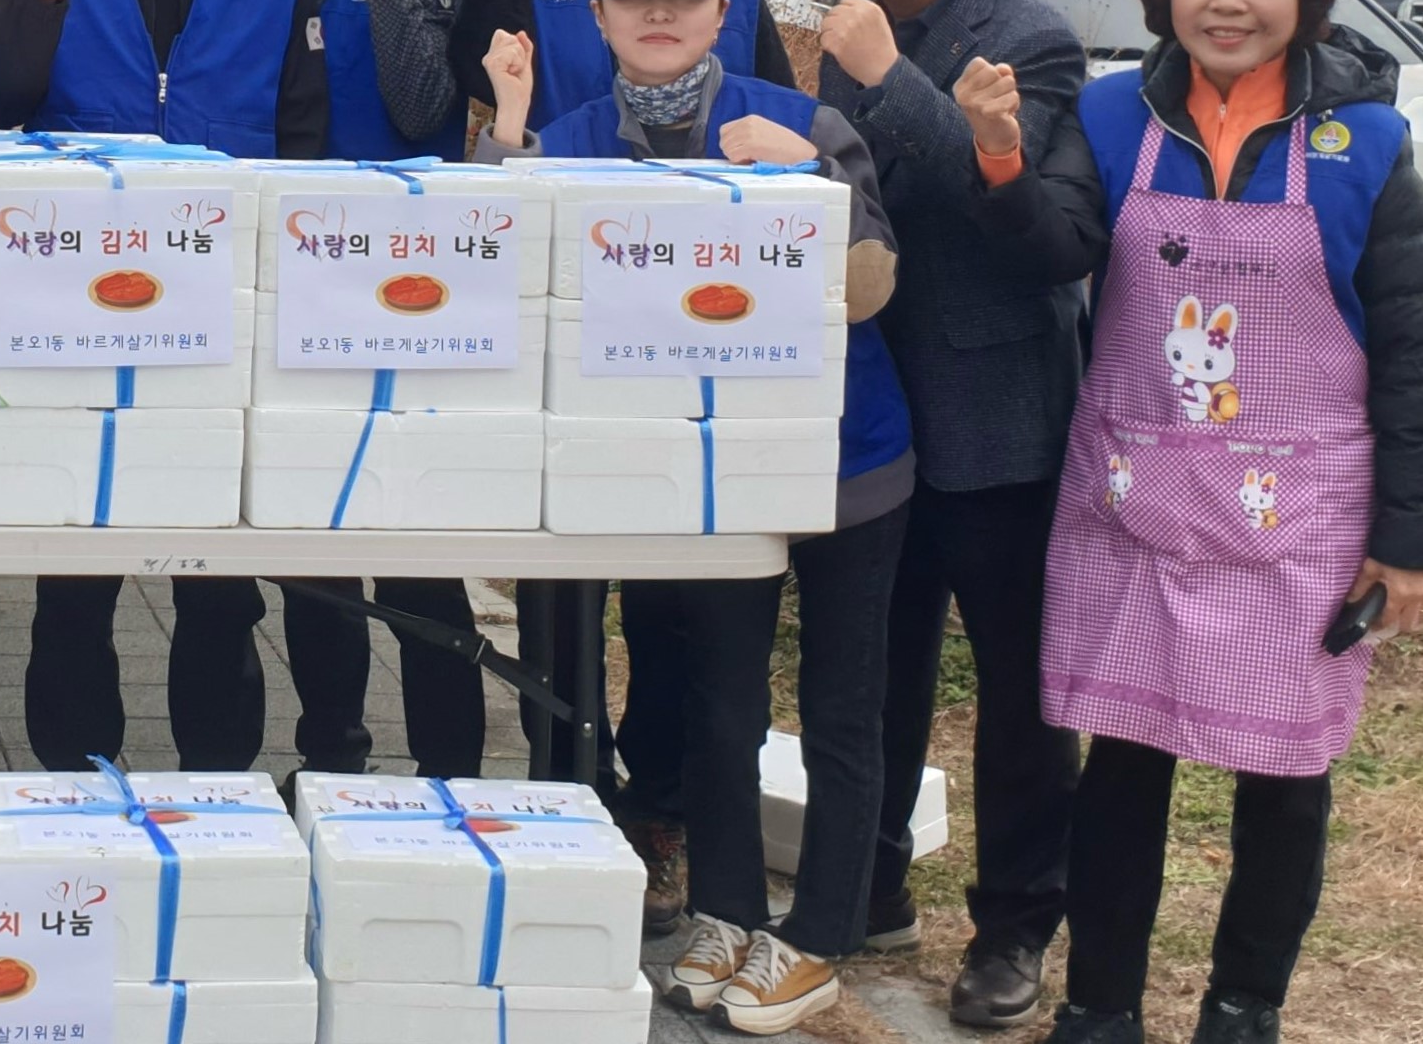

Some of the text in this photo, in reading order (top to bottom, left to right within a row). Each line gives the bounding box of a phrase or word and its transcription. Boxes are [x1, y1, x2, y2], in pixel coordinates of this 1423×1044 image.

[6, 229, 213, 256] 사랑의 김치 나눔
[295, 232, 500, 259] 사랑의 김치 나눔
[600, 240, 804, 268] 사랑의 김치 나눔
[11, 334, 206, 351] 본오1동 바르게살기위원회
[301, 338, 492, 353] 본오1동 바르게살기위원회
[605, 346, 796, 361] 본오1동 바르게살기위원회
[352, 800, 427, 812] 사랑의
[42, 910, 93, 936] 나눔
